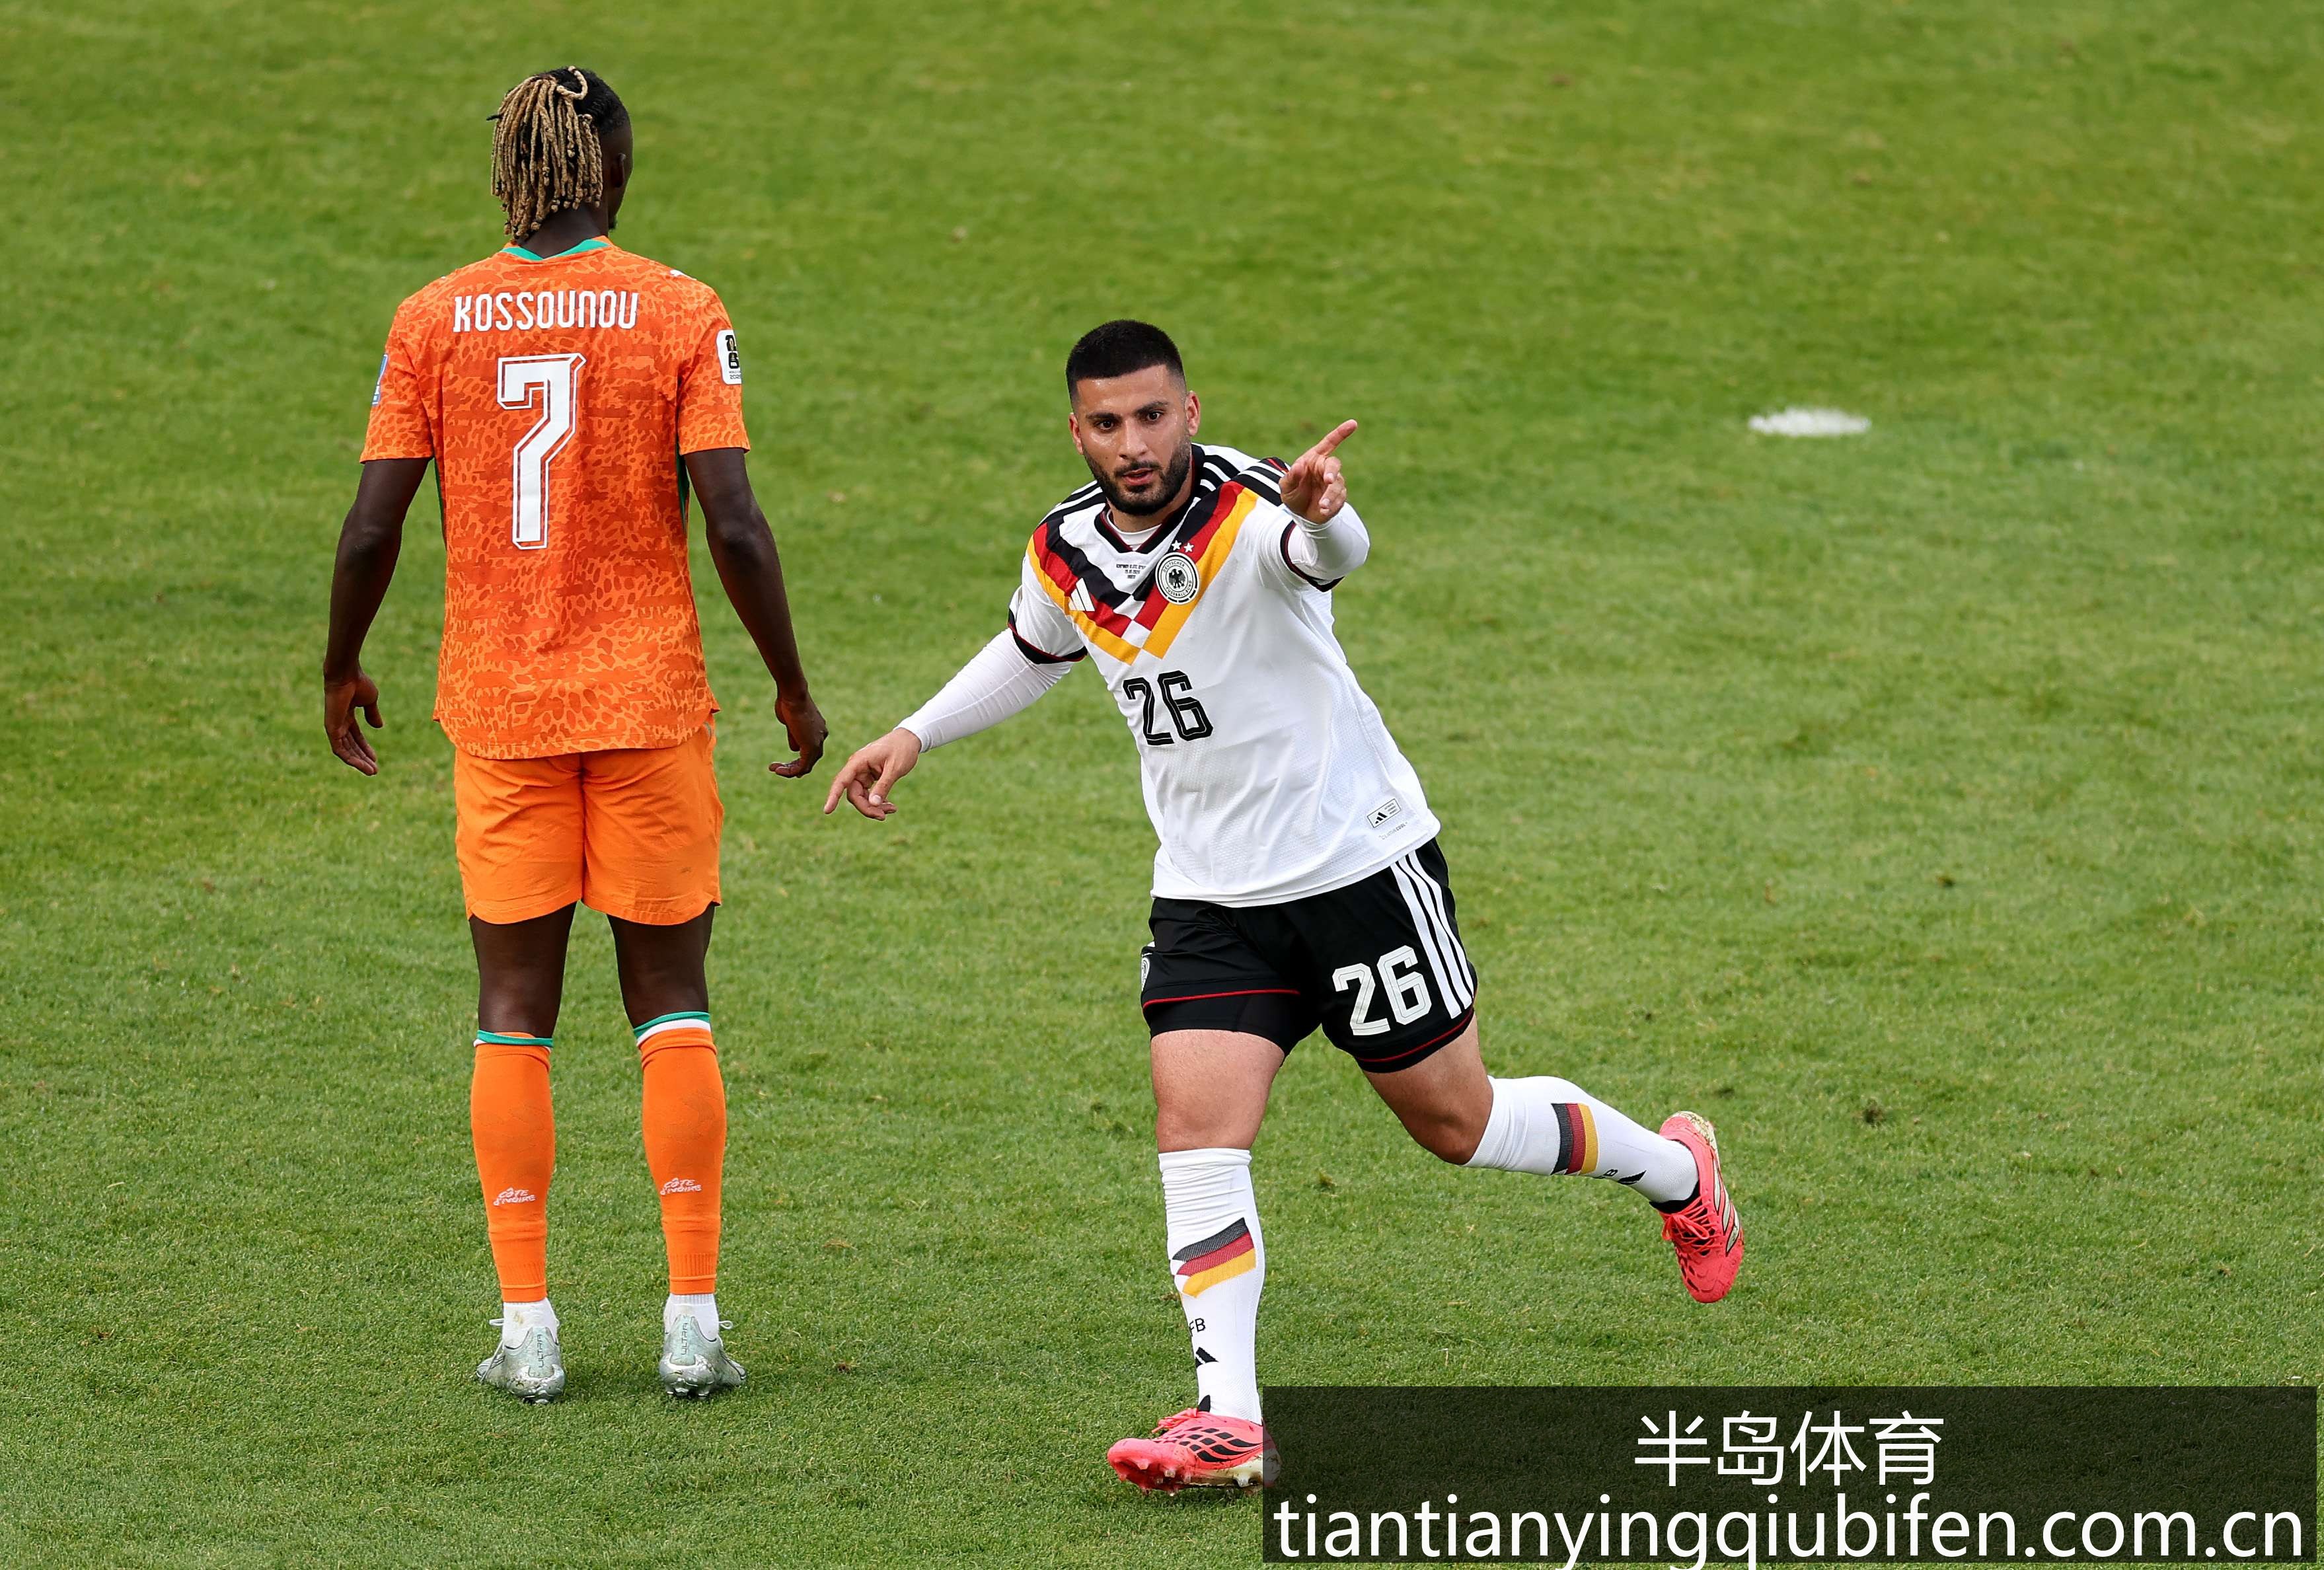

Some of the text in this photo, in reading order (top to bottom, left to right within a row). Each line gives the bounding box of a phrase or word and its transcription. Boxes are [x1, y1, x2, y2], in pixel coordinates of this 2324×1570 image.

[453, 290, 640, 332] KOSSOUNOU
[497, 352, 587, 550] 7
[1163, 560, 1185, 573] DEUTSCHER
[1122, 670, 1214, 746] 26
[1331, 945, 1433, 1036] 26
